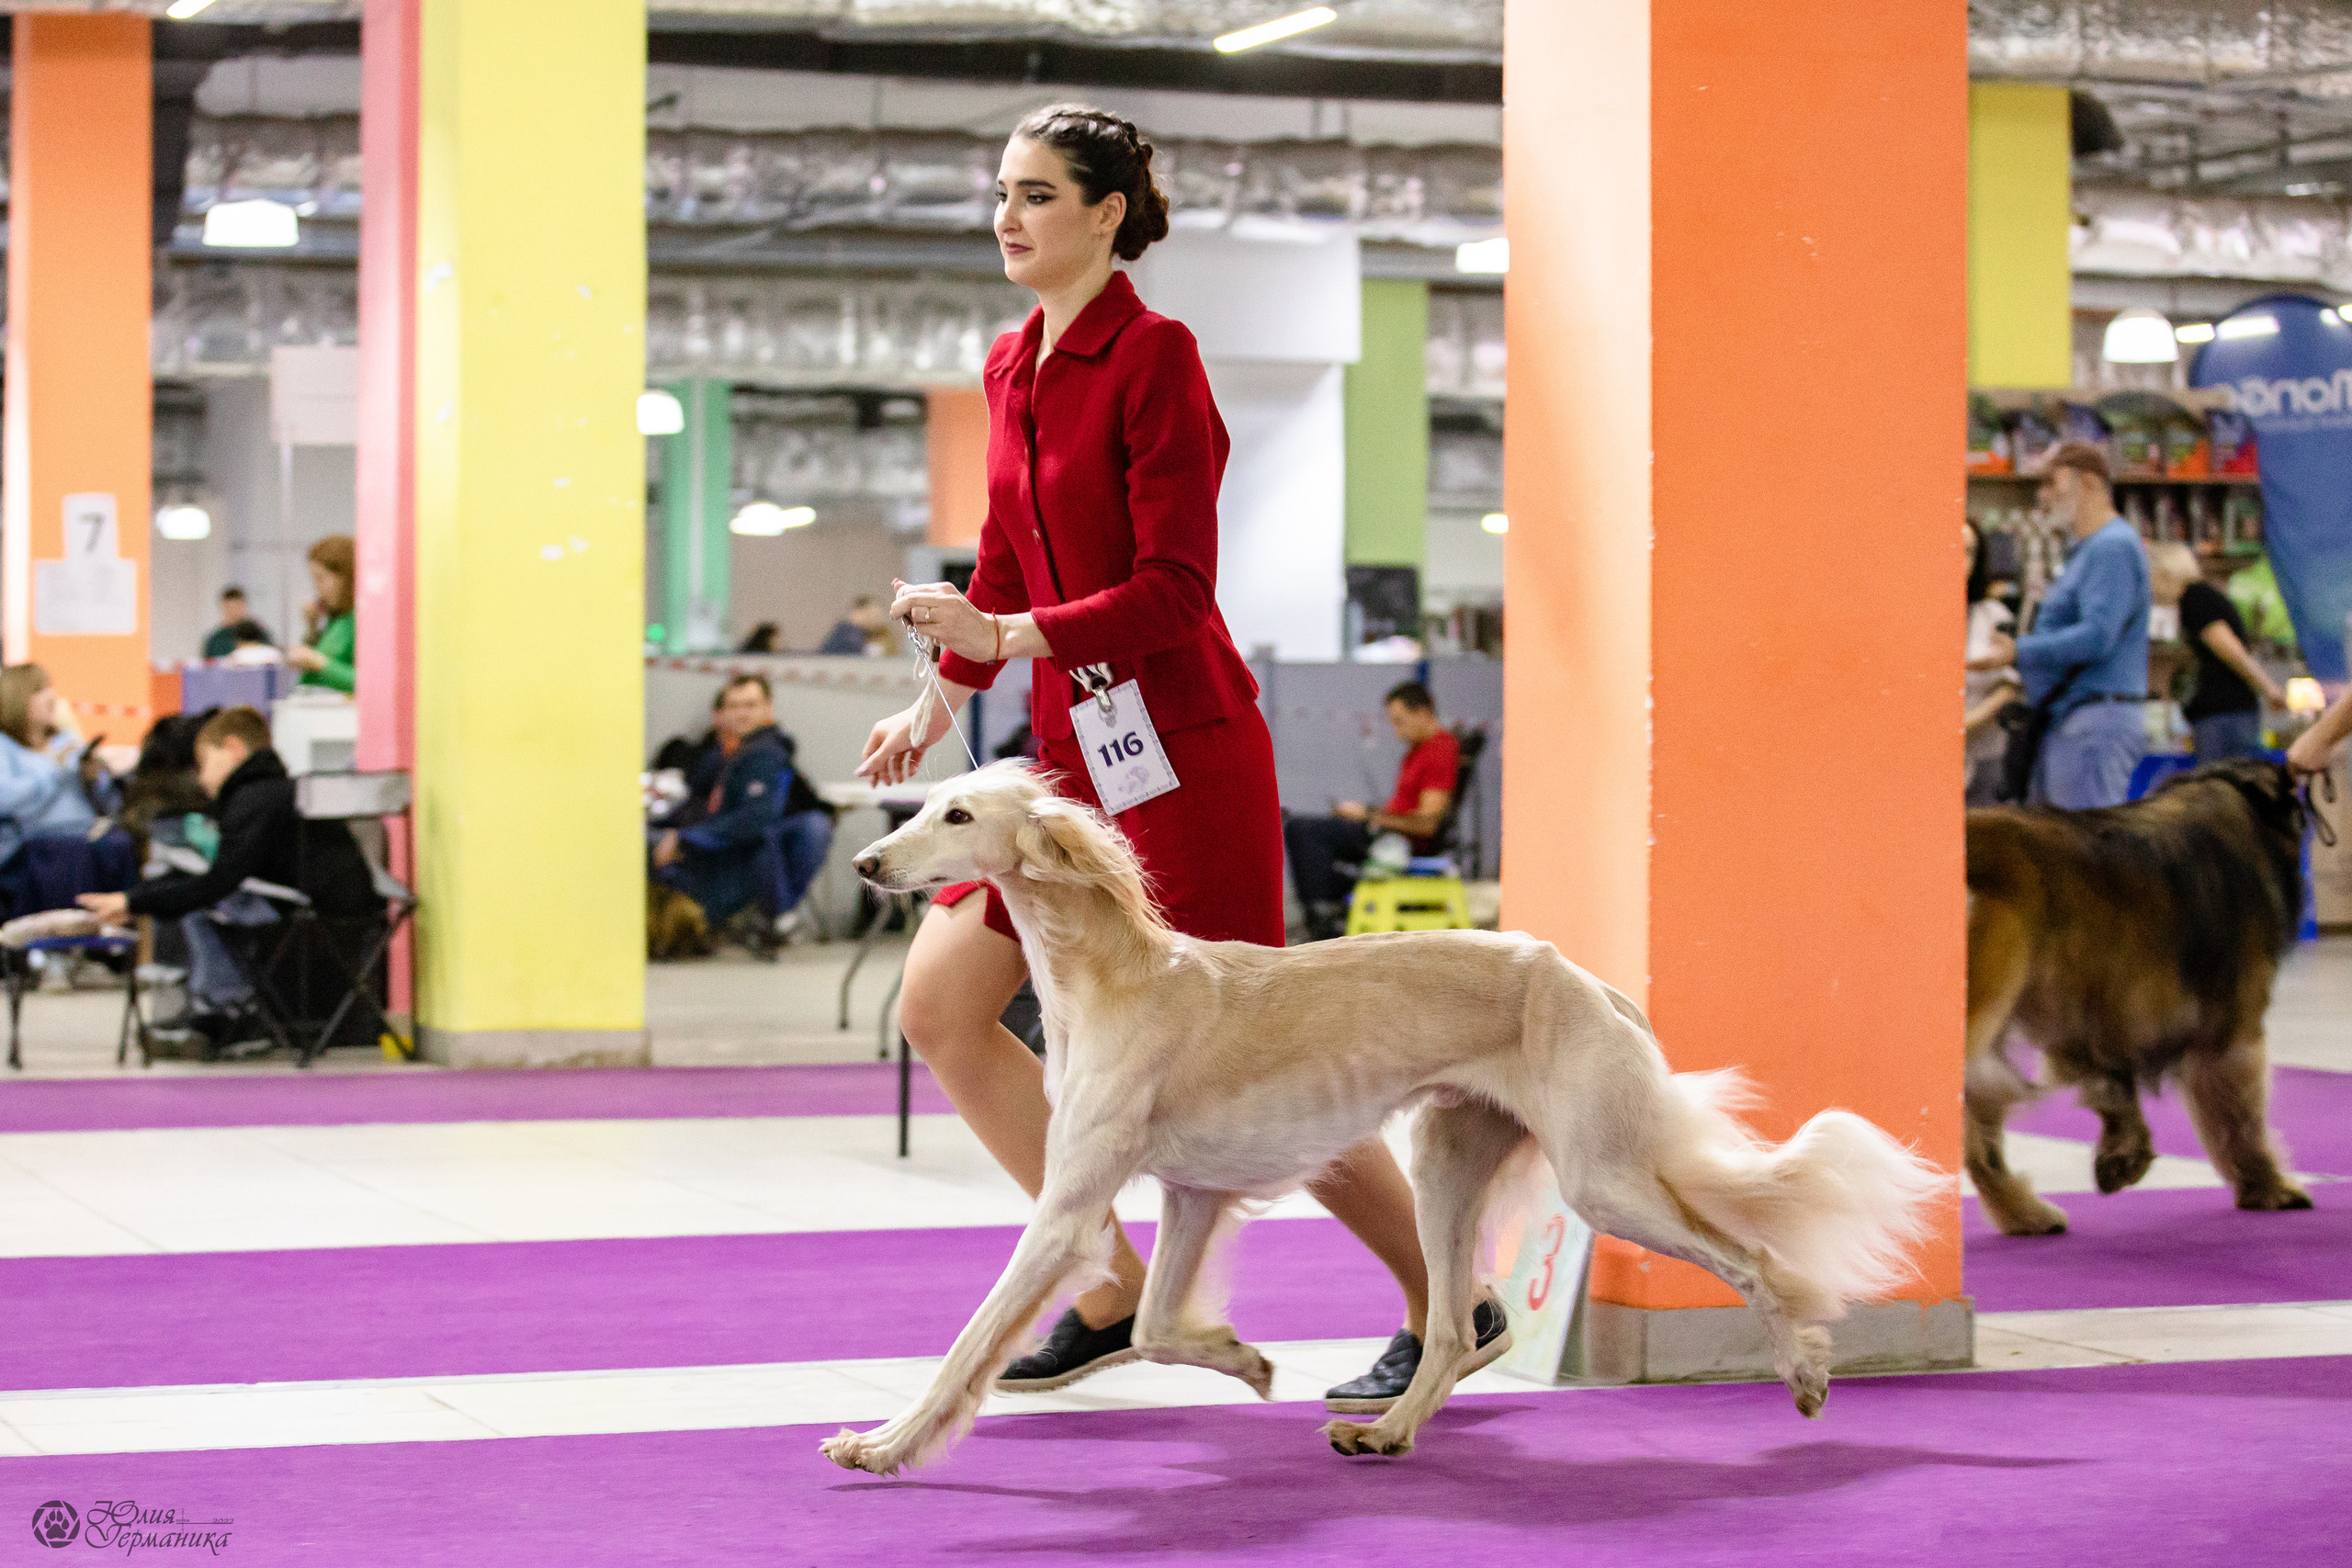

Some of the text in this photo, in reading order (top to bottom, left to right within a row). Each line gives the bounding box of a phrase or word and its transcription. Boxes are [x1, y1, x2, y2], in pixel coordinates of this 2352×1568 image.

[76, 511, 107, 554] 7
[1097, 730, 1145, 770] 116
[1527, 1213, 1566, 1312] 3
